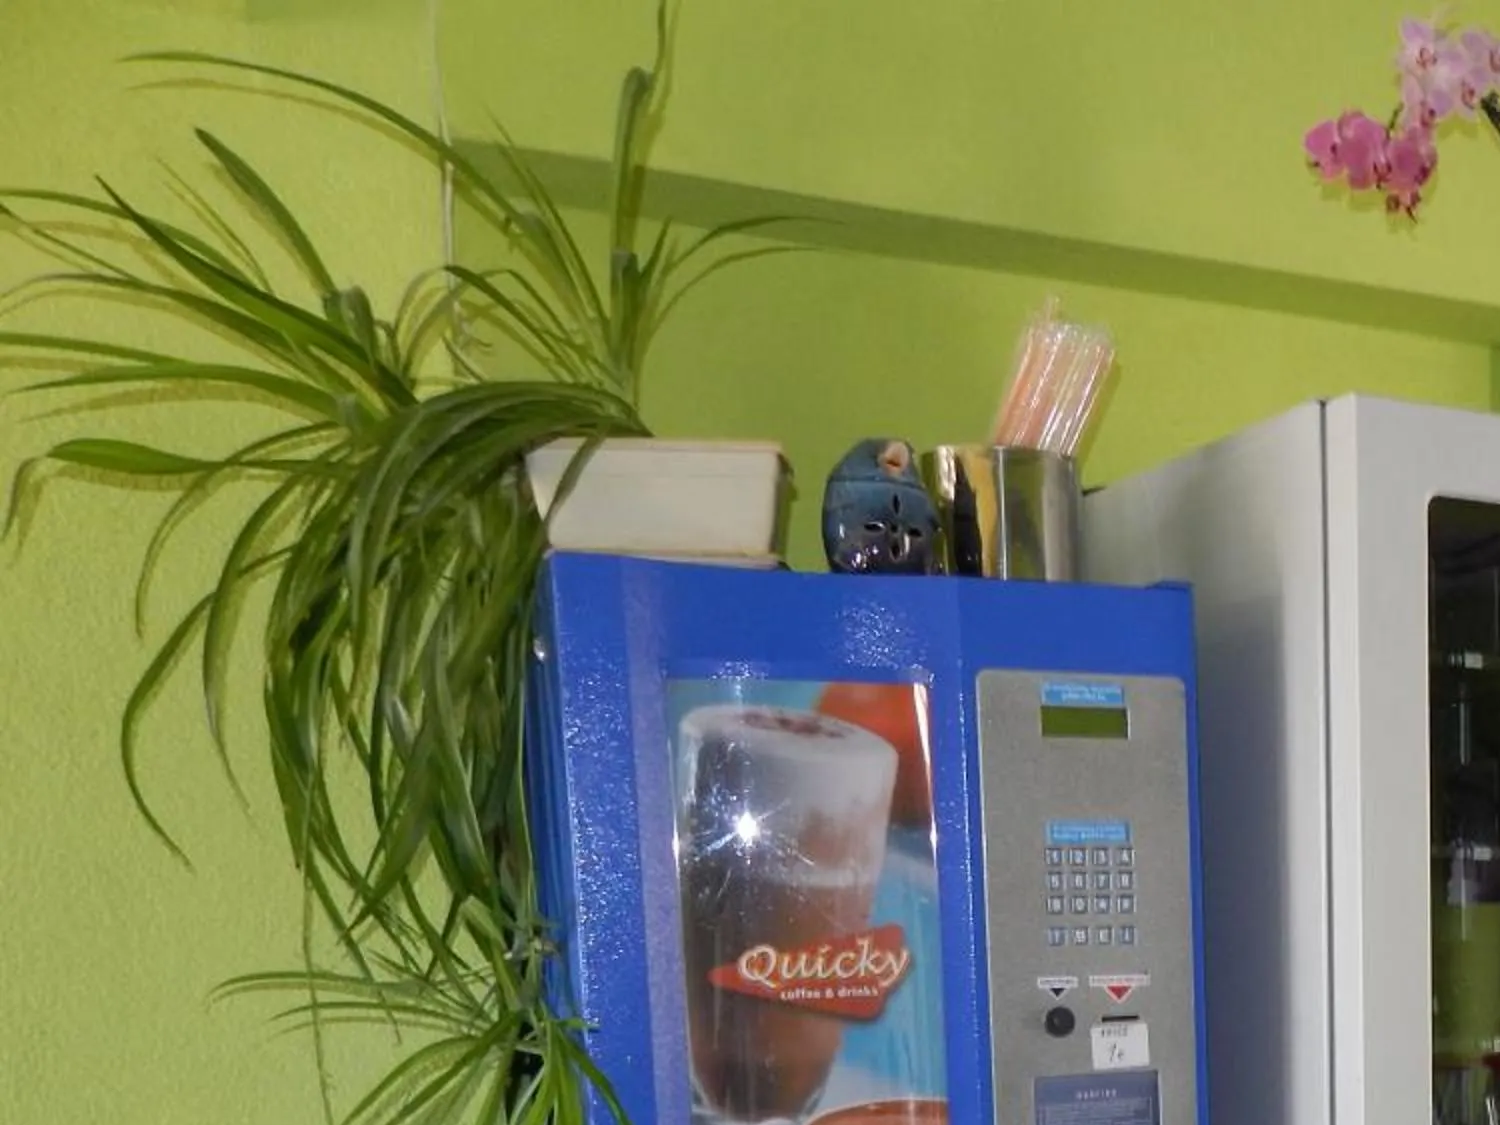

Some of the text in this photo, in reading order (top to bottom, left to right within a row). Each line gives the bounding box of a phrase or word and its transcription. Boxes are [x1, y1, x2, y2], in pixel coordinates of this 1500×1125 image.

[738, 936, 911, 988] Quicky
[780, 986, 821, 1000] coffee
[837, 985, 879, 998] drinks
